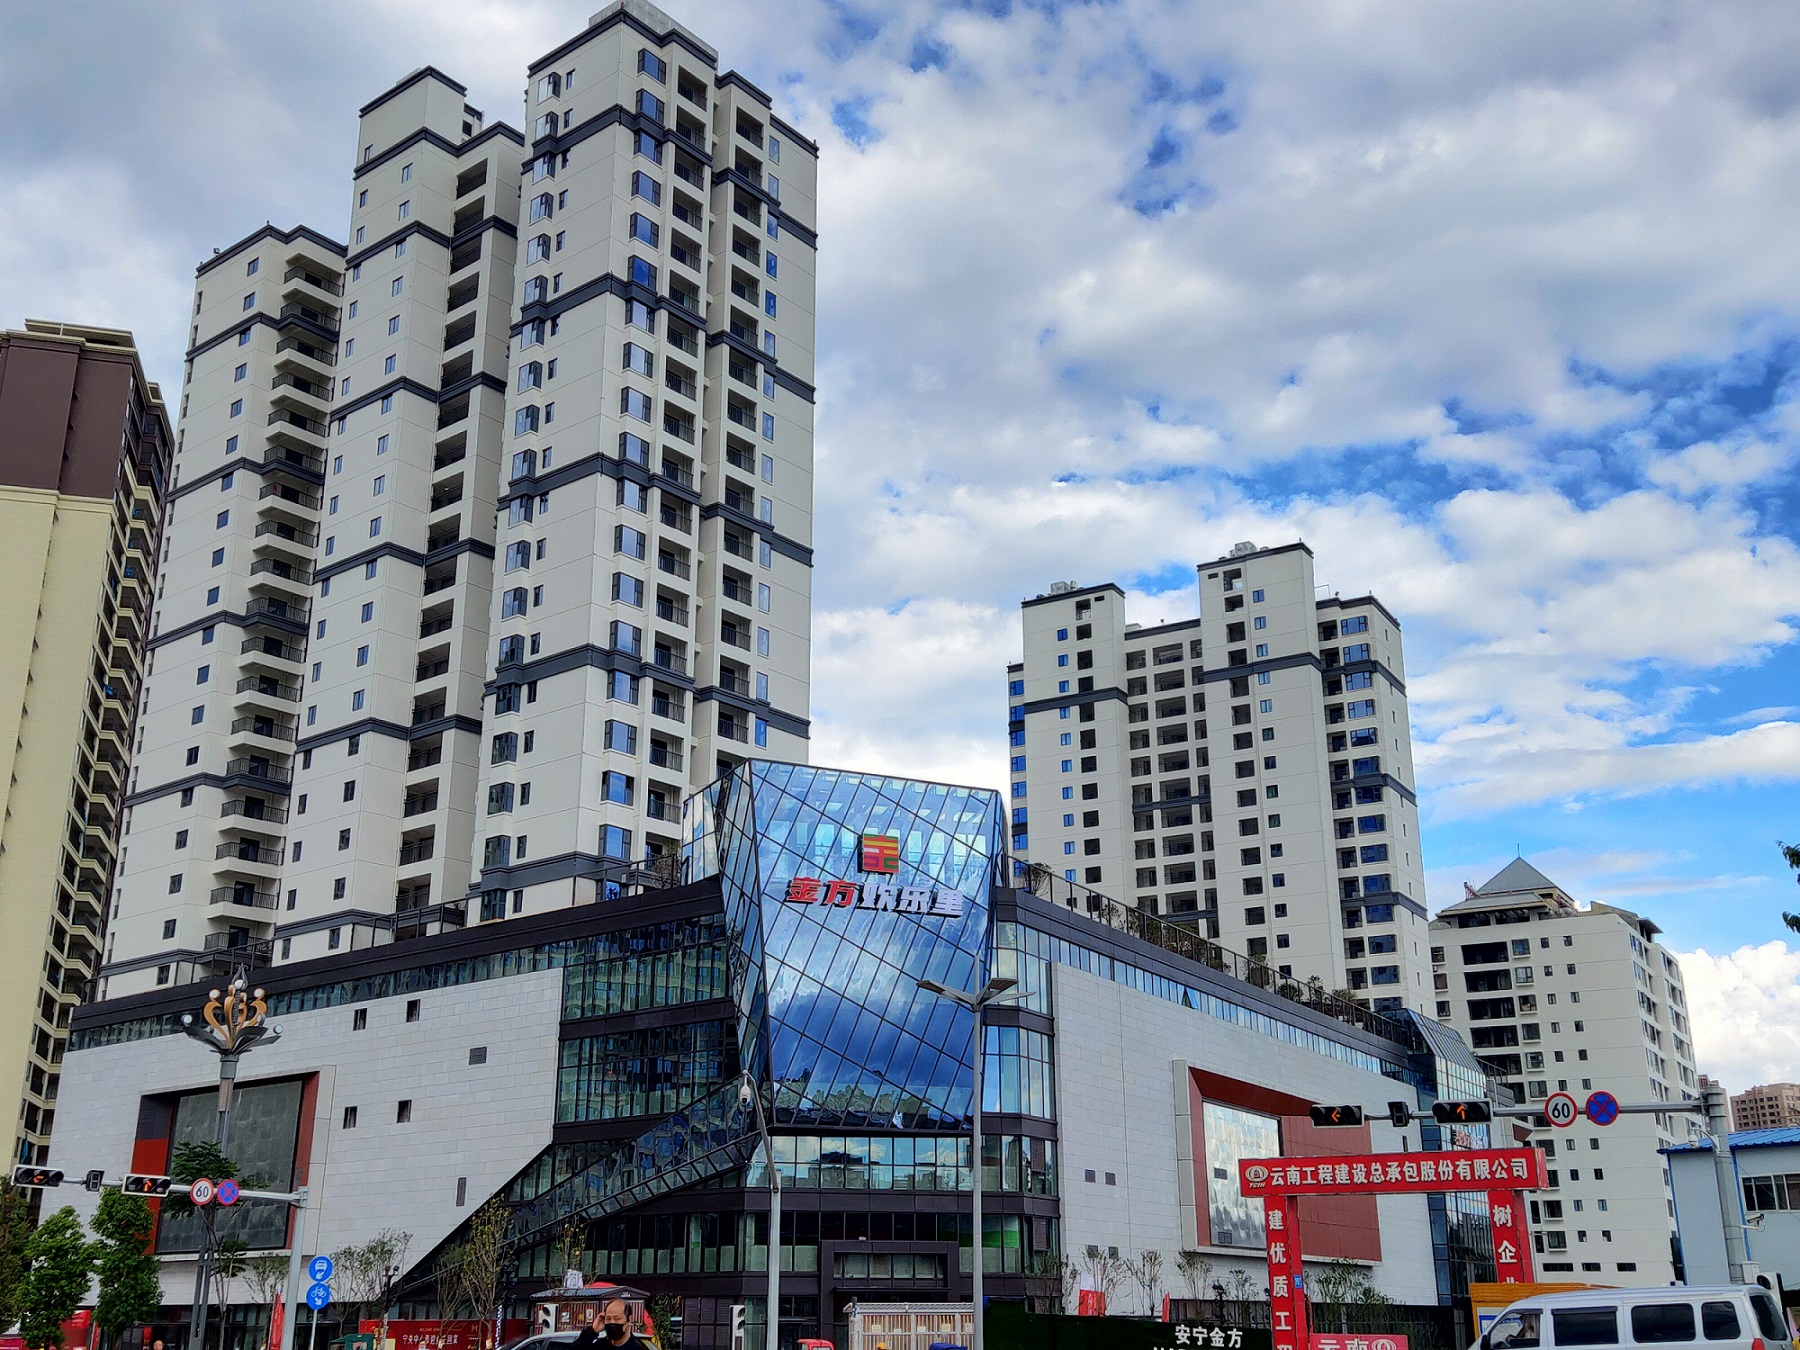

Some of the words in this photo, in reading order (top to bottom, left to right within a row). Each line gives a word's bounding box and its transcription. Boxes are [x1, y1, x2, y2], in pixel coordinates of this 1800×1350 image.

[1552, 1102, 1571, 1119] 60
[1270, 1157, 1528, 1186] 云南工程建设总承包股份有限公司
[195, 1185, 209, 1199] 60
[1492, 1203, 1519, 1284] 树企
[1268, 1209, 1293, 1350] 建优质工
[1175, 1324, 1243, 1348] 安宁金方
